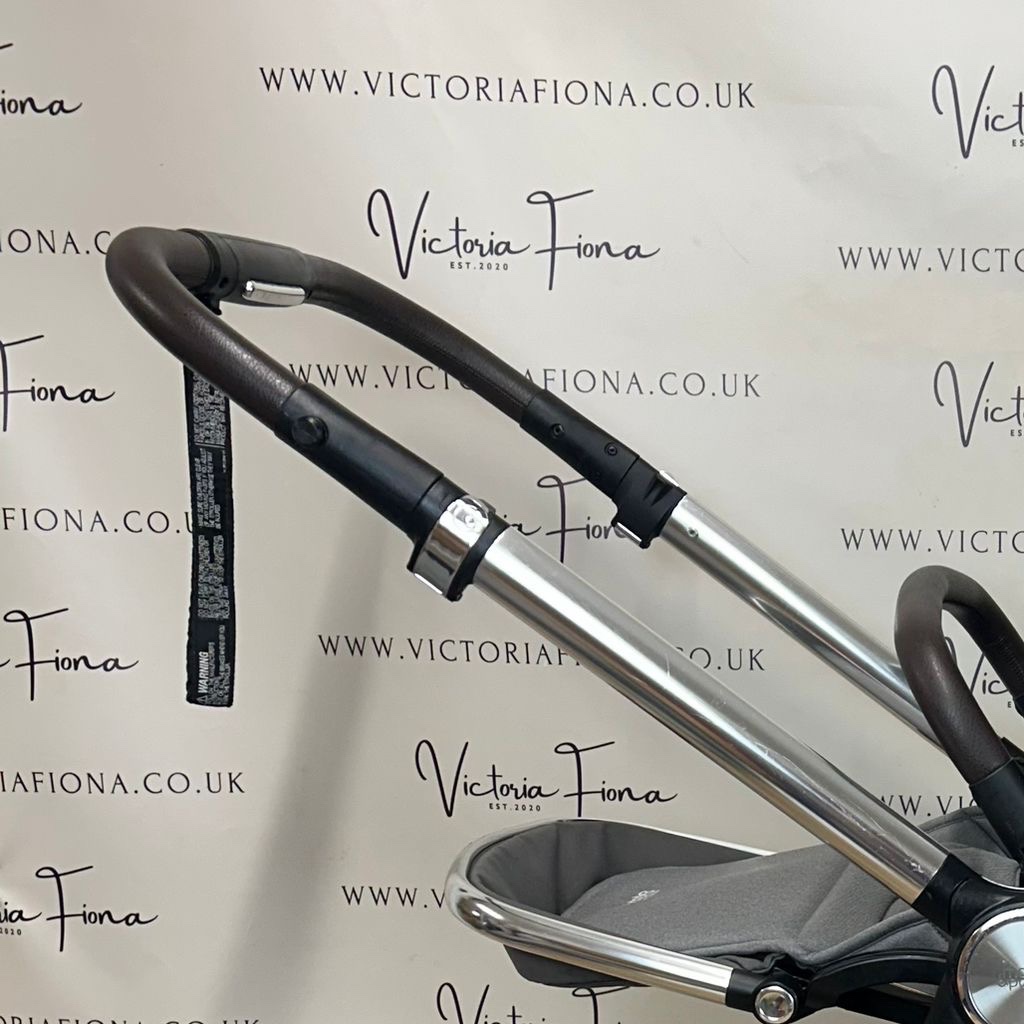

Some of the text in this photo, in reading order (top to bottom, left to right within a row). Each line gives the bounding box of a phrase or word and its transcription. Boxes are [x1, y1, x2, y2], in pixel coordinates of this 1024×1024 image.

[0, 43, 82, 116] iona
[259, 67, 755, 108] WWW.VICTORIAFIONA.CO.UK
[367, 189, 661, 291] Victoria Fiona
[449, 261, 509, 270] EST.2020
[3, 608, 139, 701] Fiona
[198, 651, 209, 693] WARNING
[0, 771, 245, 794] IAFIONA.CO.UK
[415, 740, 678, 817] Victoria Fiona
[489, 803, 540, 812] EST.2020
[35, 866, 158, 952] Fiona
